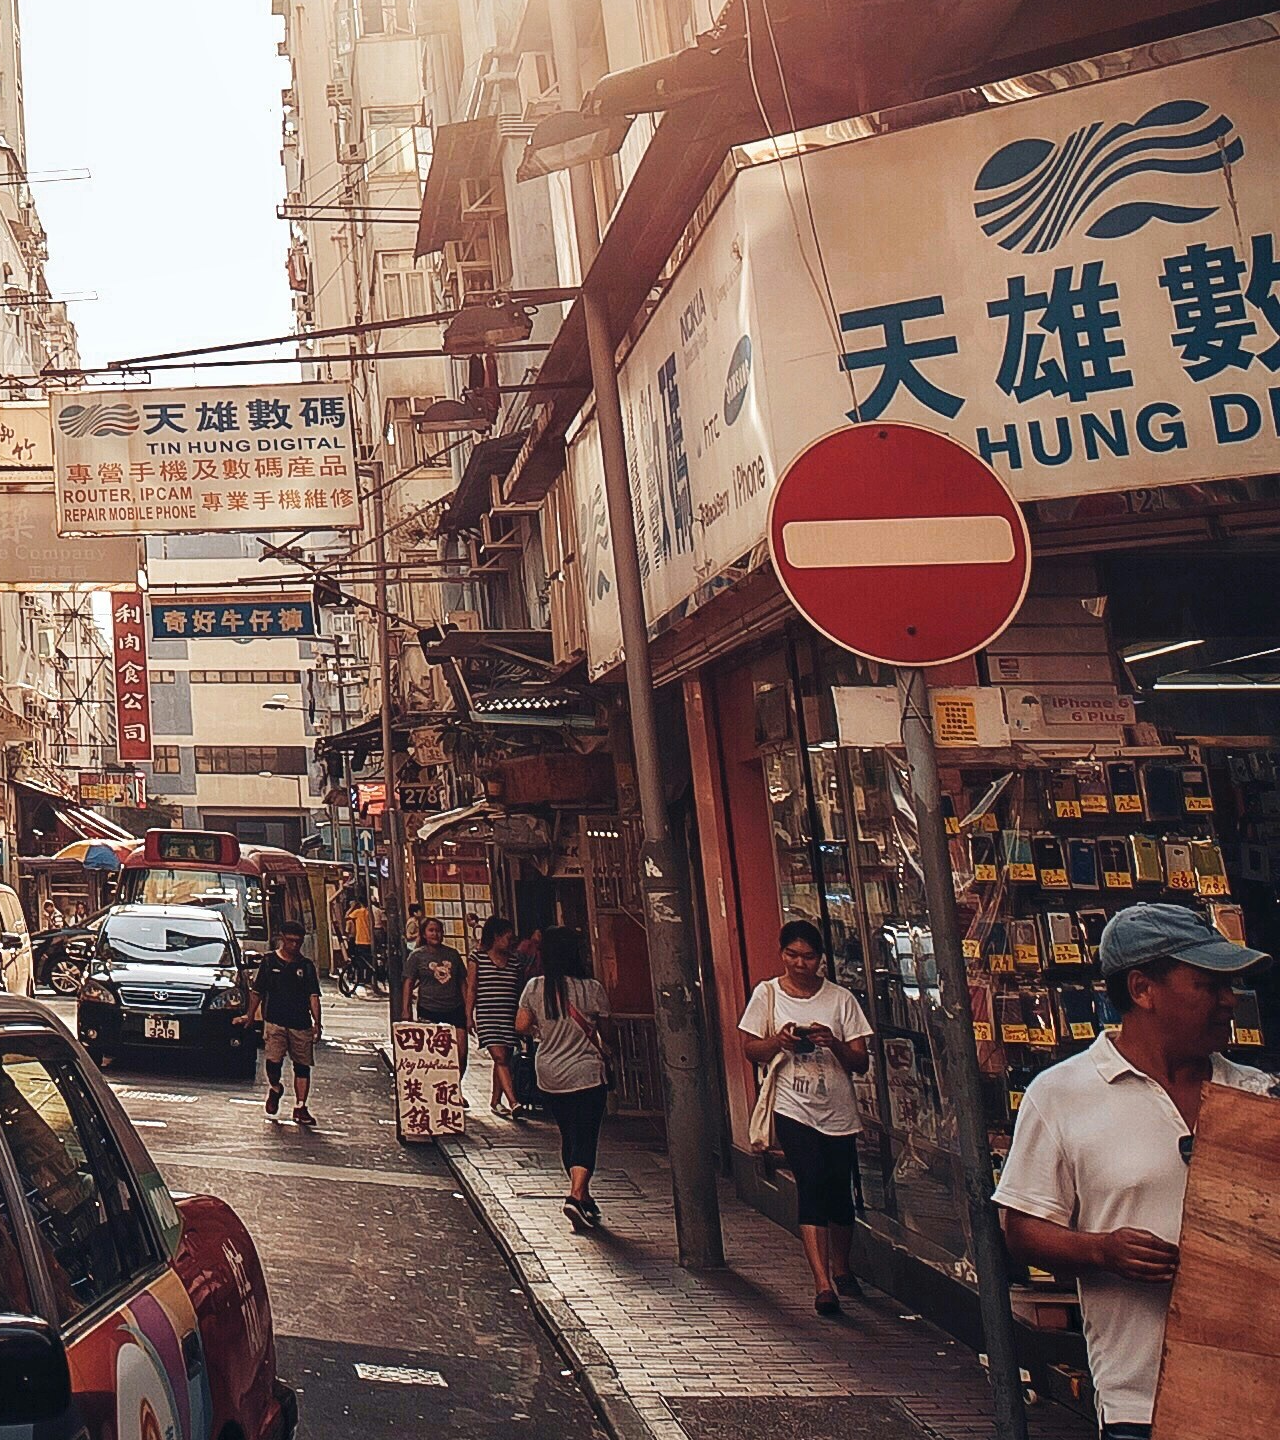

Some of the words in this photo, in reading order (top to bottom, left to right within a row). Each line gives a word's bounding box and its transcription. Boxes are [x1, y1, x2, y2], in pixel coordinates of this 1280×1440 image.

[679, 287, 706, 348] NOKIA
[143, 396, 346, 435] 天雄數碼
[146, 441, 181, 455] TIN
[189, 438, 251, 454] HUNG
[258, 436, 346, 452] DIGITAL
[976, 401, 1189, 470] HUNG
[64, 487, 136, 504] ROUTER,
[201, 488, 354, 512] 專業手機維修
[64, 507, 107, 522] REPAIR
[109, 506, 153, 521] MOBILE
[156, 504, 197, 520] PHONE
[15, 544, 108, 563] Company
[114, 603, 146, 743] 利肉食公司
[1052, 696, 1113, 709] iPhone
[1118, 696, 1130, 709] 6
[1071, 711, 1082, 722] 6
[1087, 711, 1126, 722] Plus
[395, 1025, 458, 1057] 四海
